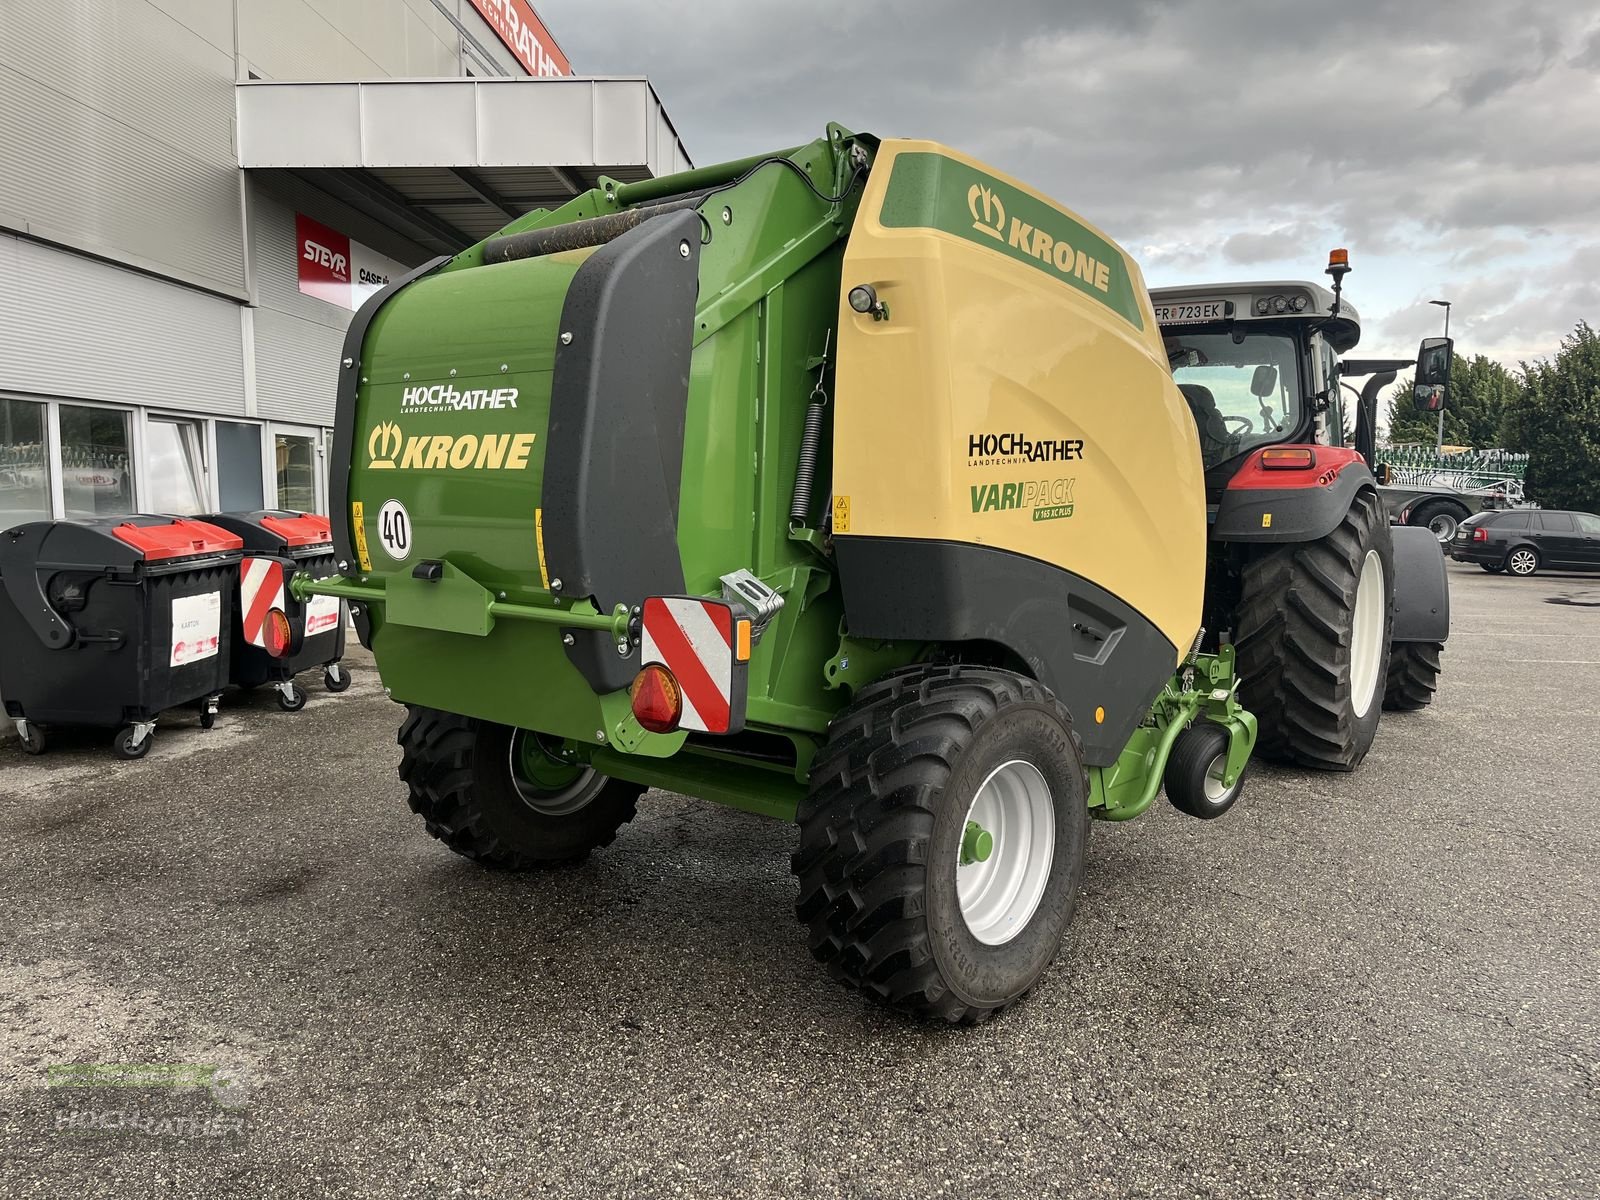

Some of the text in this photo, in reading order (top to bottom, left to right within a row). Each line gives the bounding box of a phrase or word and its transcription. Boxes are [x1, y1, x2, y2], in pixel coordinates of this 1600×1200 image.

[303, 239, 346, 275] STEYR
[1008, 216, 1110, 293] KRONE
[1178, 305, 1201, 320] 723
[1203, 303, 1219, 318] EK
[400, 405, 453, 414] LANDTECHNIK
[402, 384, 519, 411] HOCHRATHER
[400, 433, 537, 470] KRONE
[968, 433, 1084, 462] HOCHRATHER
[968, 457, 1027, 467] LANDTECHNIK
[970, 478, 1076, 513] VARIPACK
[1035, 507, 1072, 519] V 165 XC PLUS
[383, 510, 407, 550] 40
